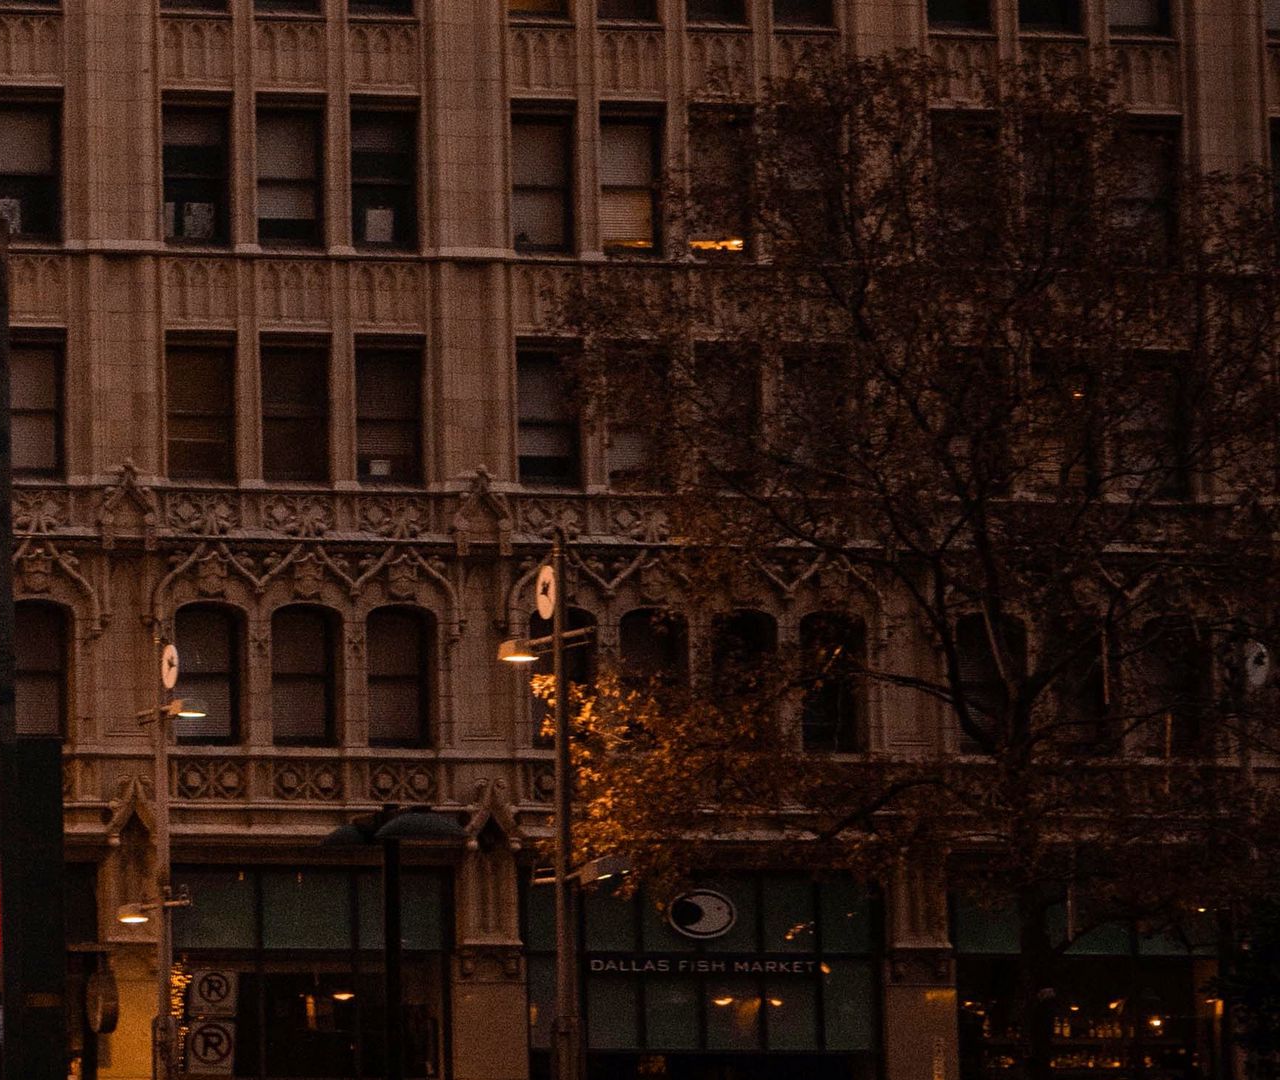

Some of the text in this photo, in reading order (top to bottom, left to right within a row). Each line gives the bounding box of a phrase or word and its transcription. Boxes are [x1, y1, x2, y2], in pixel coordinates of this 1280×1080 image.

[590, 959, 816, 973] DALLAS FISH MARKET
